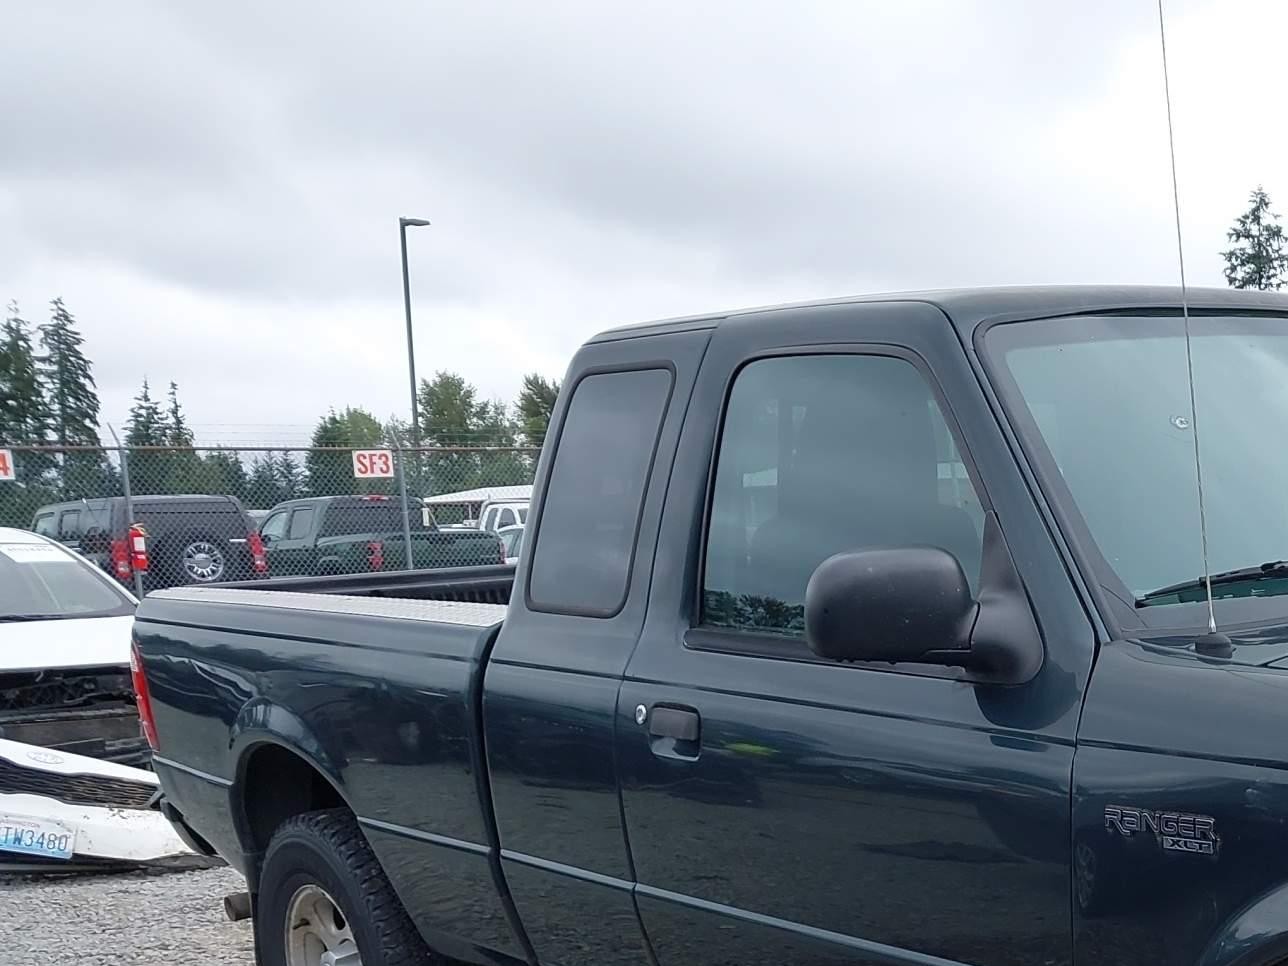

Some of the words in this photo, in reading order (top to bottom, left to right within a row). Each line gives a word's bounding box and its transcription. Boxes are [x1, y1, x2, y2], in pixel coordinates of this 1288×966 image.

[356, 452, 391, 475] SF3
[1104, 805, 1218, 840] RANGER
[0, 826, 69, 852] TW3480
[1169, 838, 1209, 853] XLT
